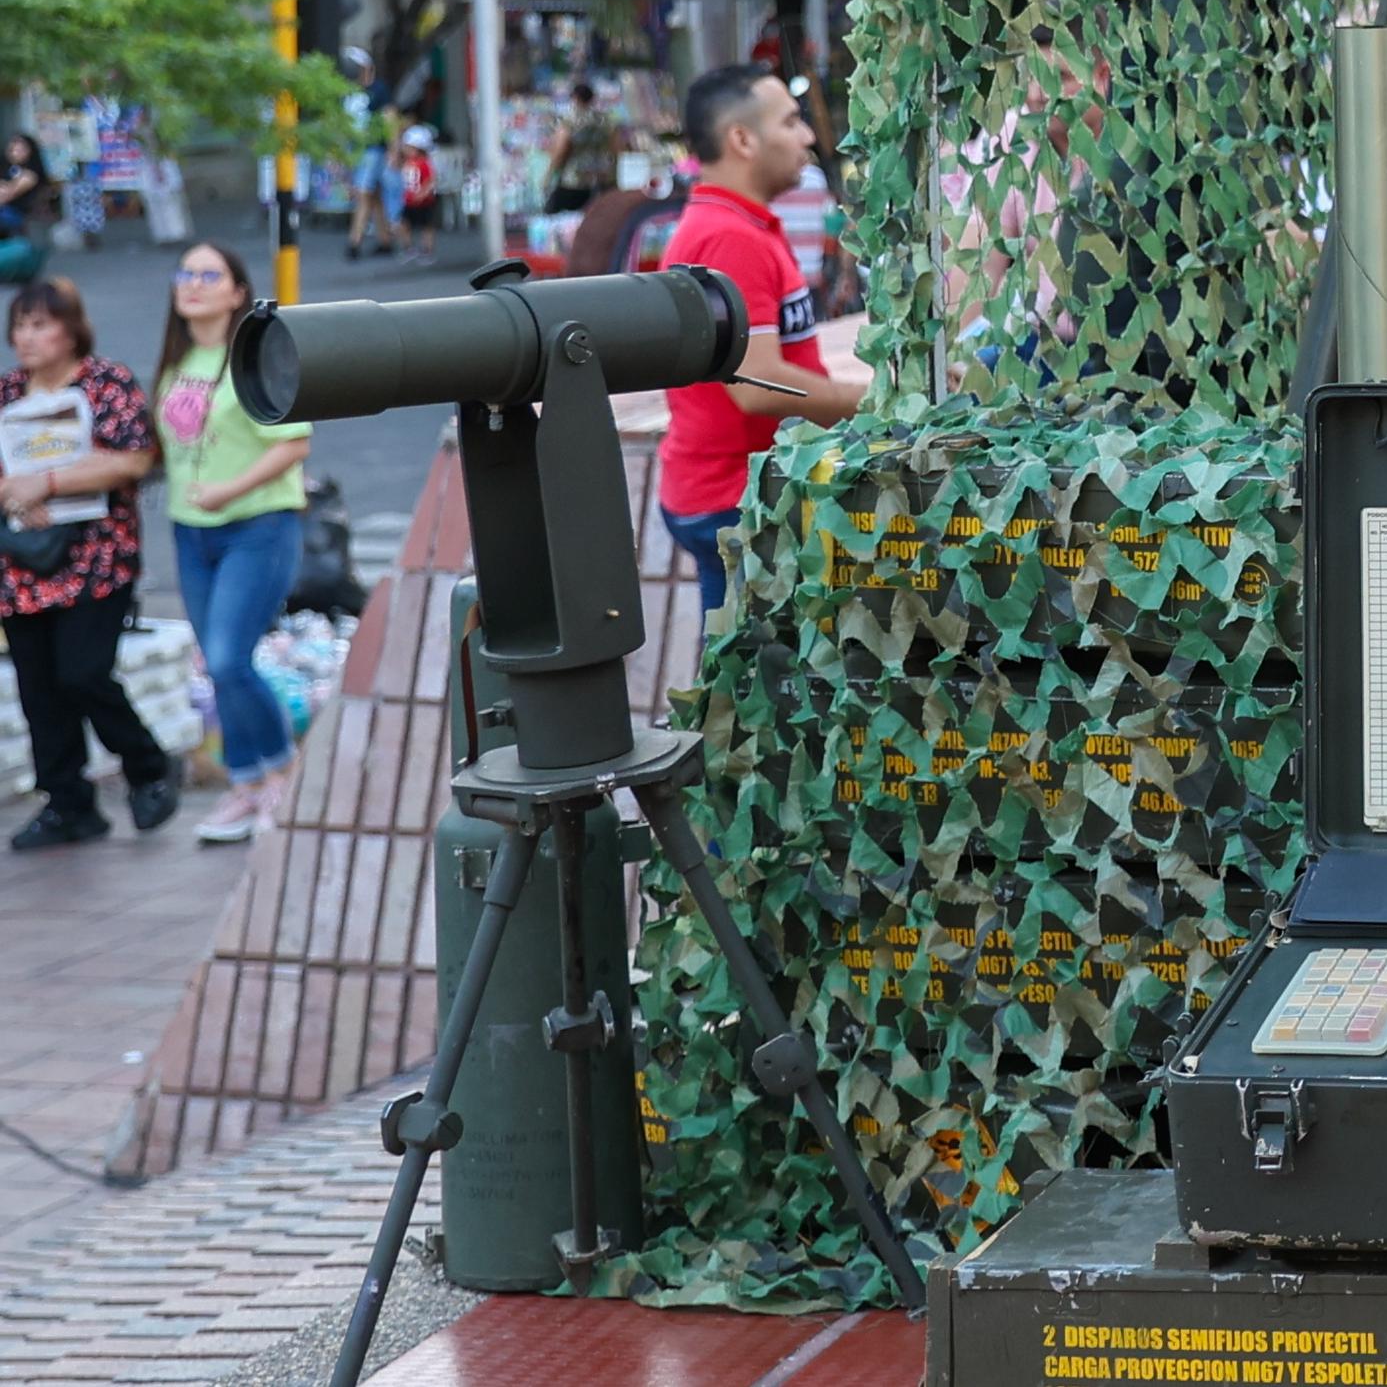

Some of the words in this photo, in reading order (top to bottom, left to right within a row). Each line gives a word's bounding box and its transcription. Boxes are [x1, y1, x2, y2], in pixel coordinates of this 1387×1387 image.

[1043, 1325, 1056, 1347] 2
[1064, 1325, 1163, 1350] DISPAROS
[1167, 1328, 1268, 1353] SEMIFIJOS
[1272, 1330, 1377, 1355] PROYECTIL
[1045, 1355, 1111, 1379] CARGA
[1114, 1357, 1238, 1382] PROYECCION
[1243, 1360, 1284, 1383] M67
[1287, 1362, 1300, 1384] Y
